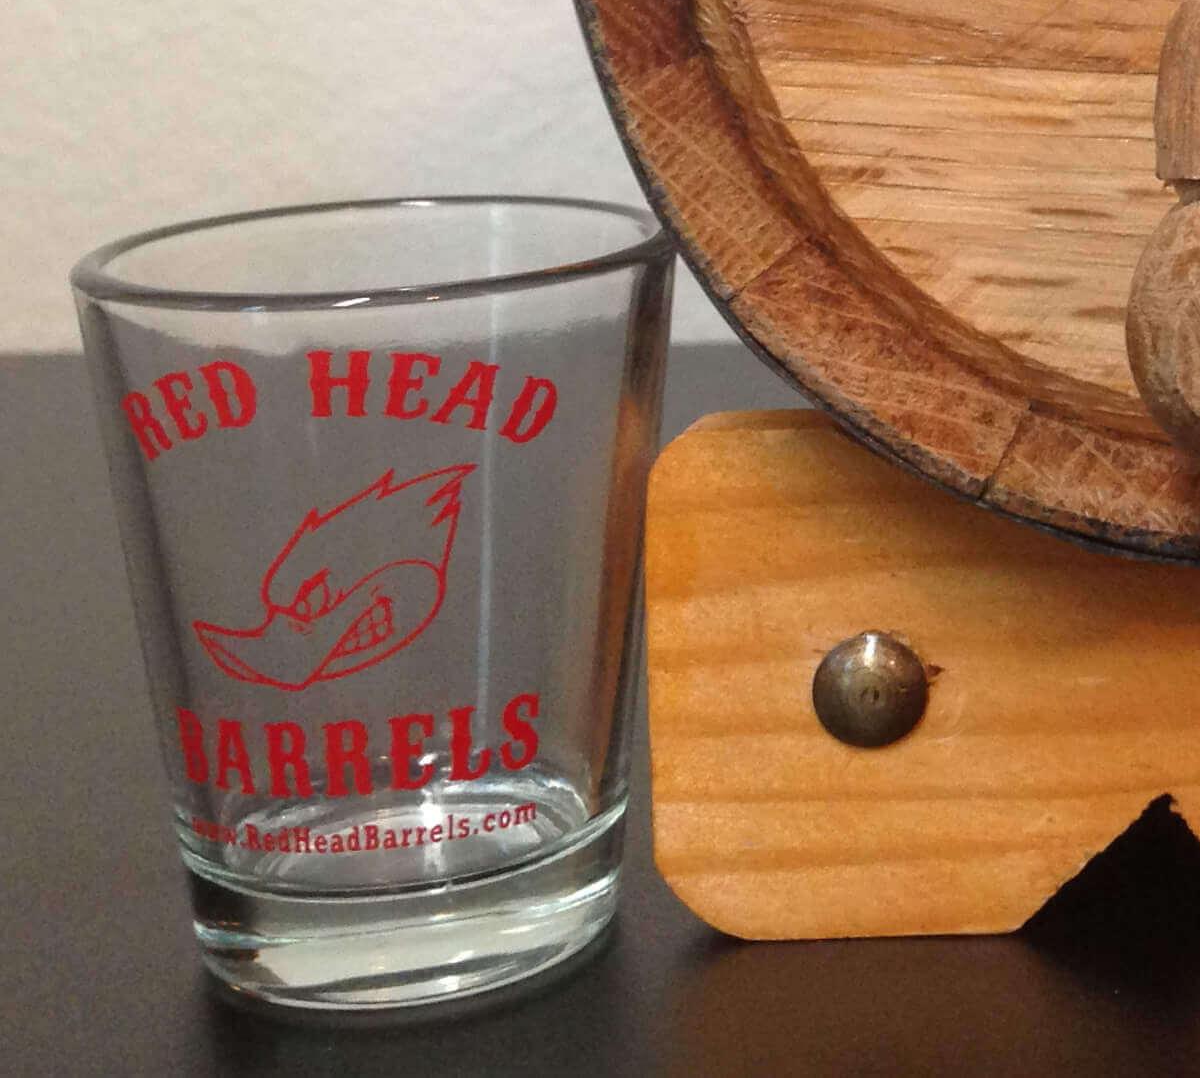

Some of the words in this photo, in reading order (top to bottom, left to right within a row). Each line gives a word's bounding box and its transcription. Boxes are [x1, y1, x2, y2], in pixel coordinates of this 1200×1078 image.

[122, 361, 256, 461] RED
[306, 350, 559, 444] HEAD
[176, 693, 542, 798] BARRELS
